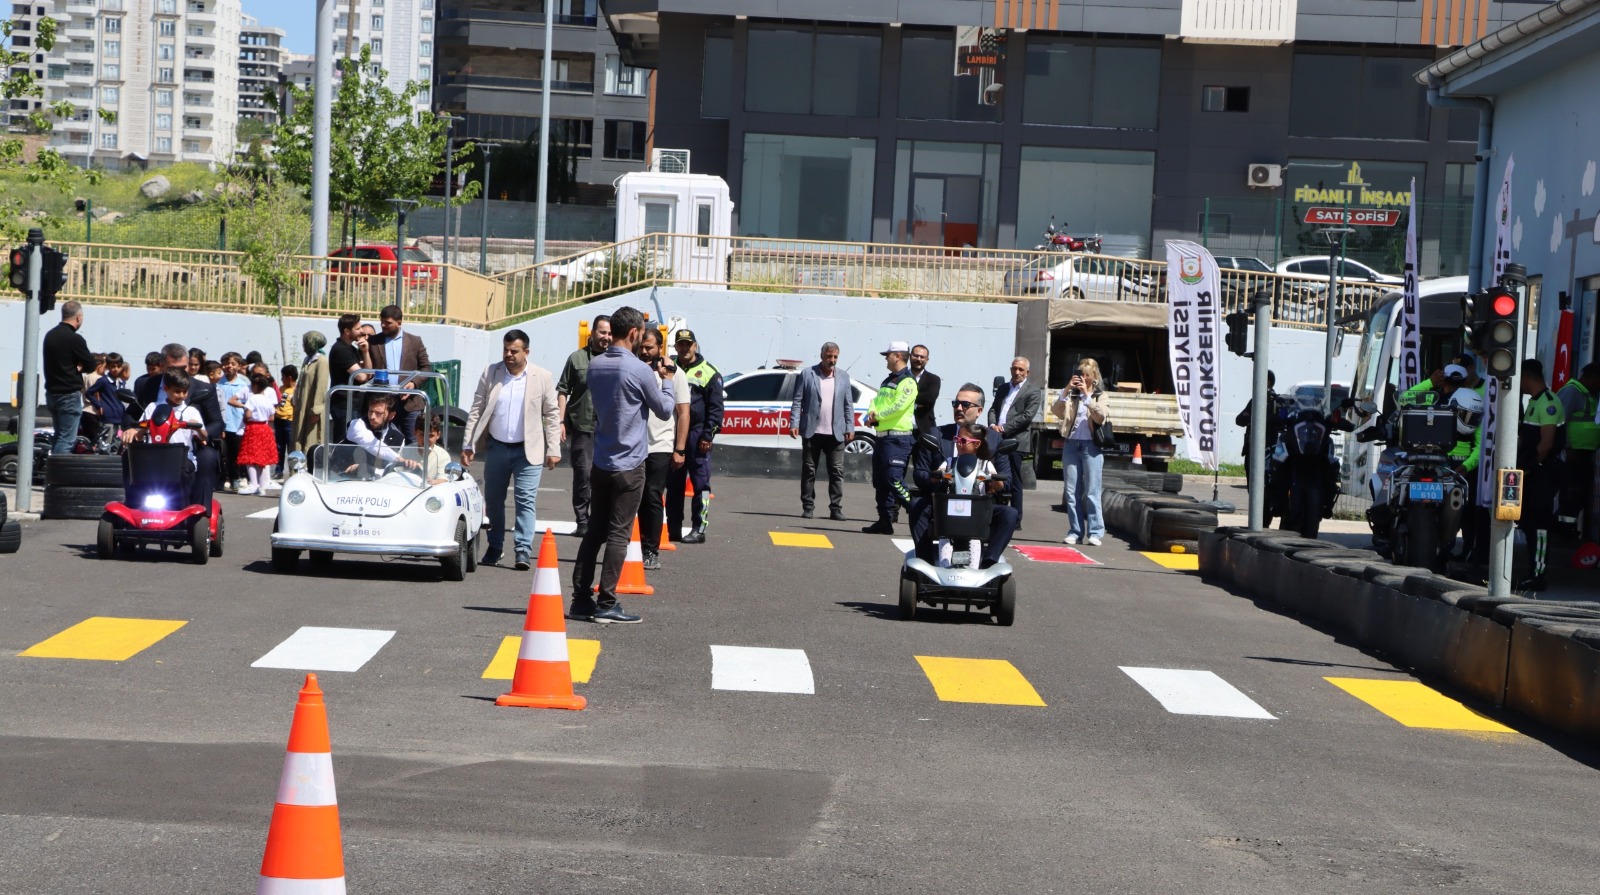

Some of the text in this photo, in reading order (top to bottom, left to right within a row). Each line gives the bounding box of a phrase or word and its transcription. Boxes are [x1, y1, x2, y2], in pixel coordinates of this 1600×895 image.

[1294, 184, 1412, 208] FİDANLI İNŞAAT
[1355, 211, 1389, 222] OFİSİ
[1411, 483, 1422, 491] 63
[336, 494, 392, 508] TRAFİK POLİSİ
